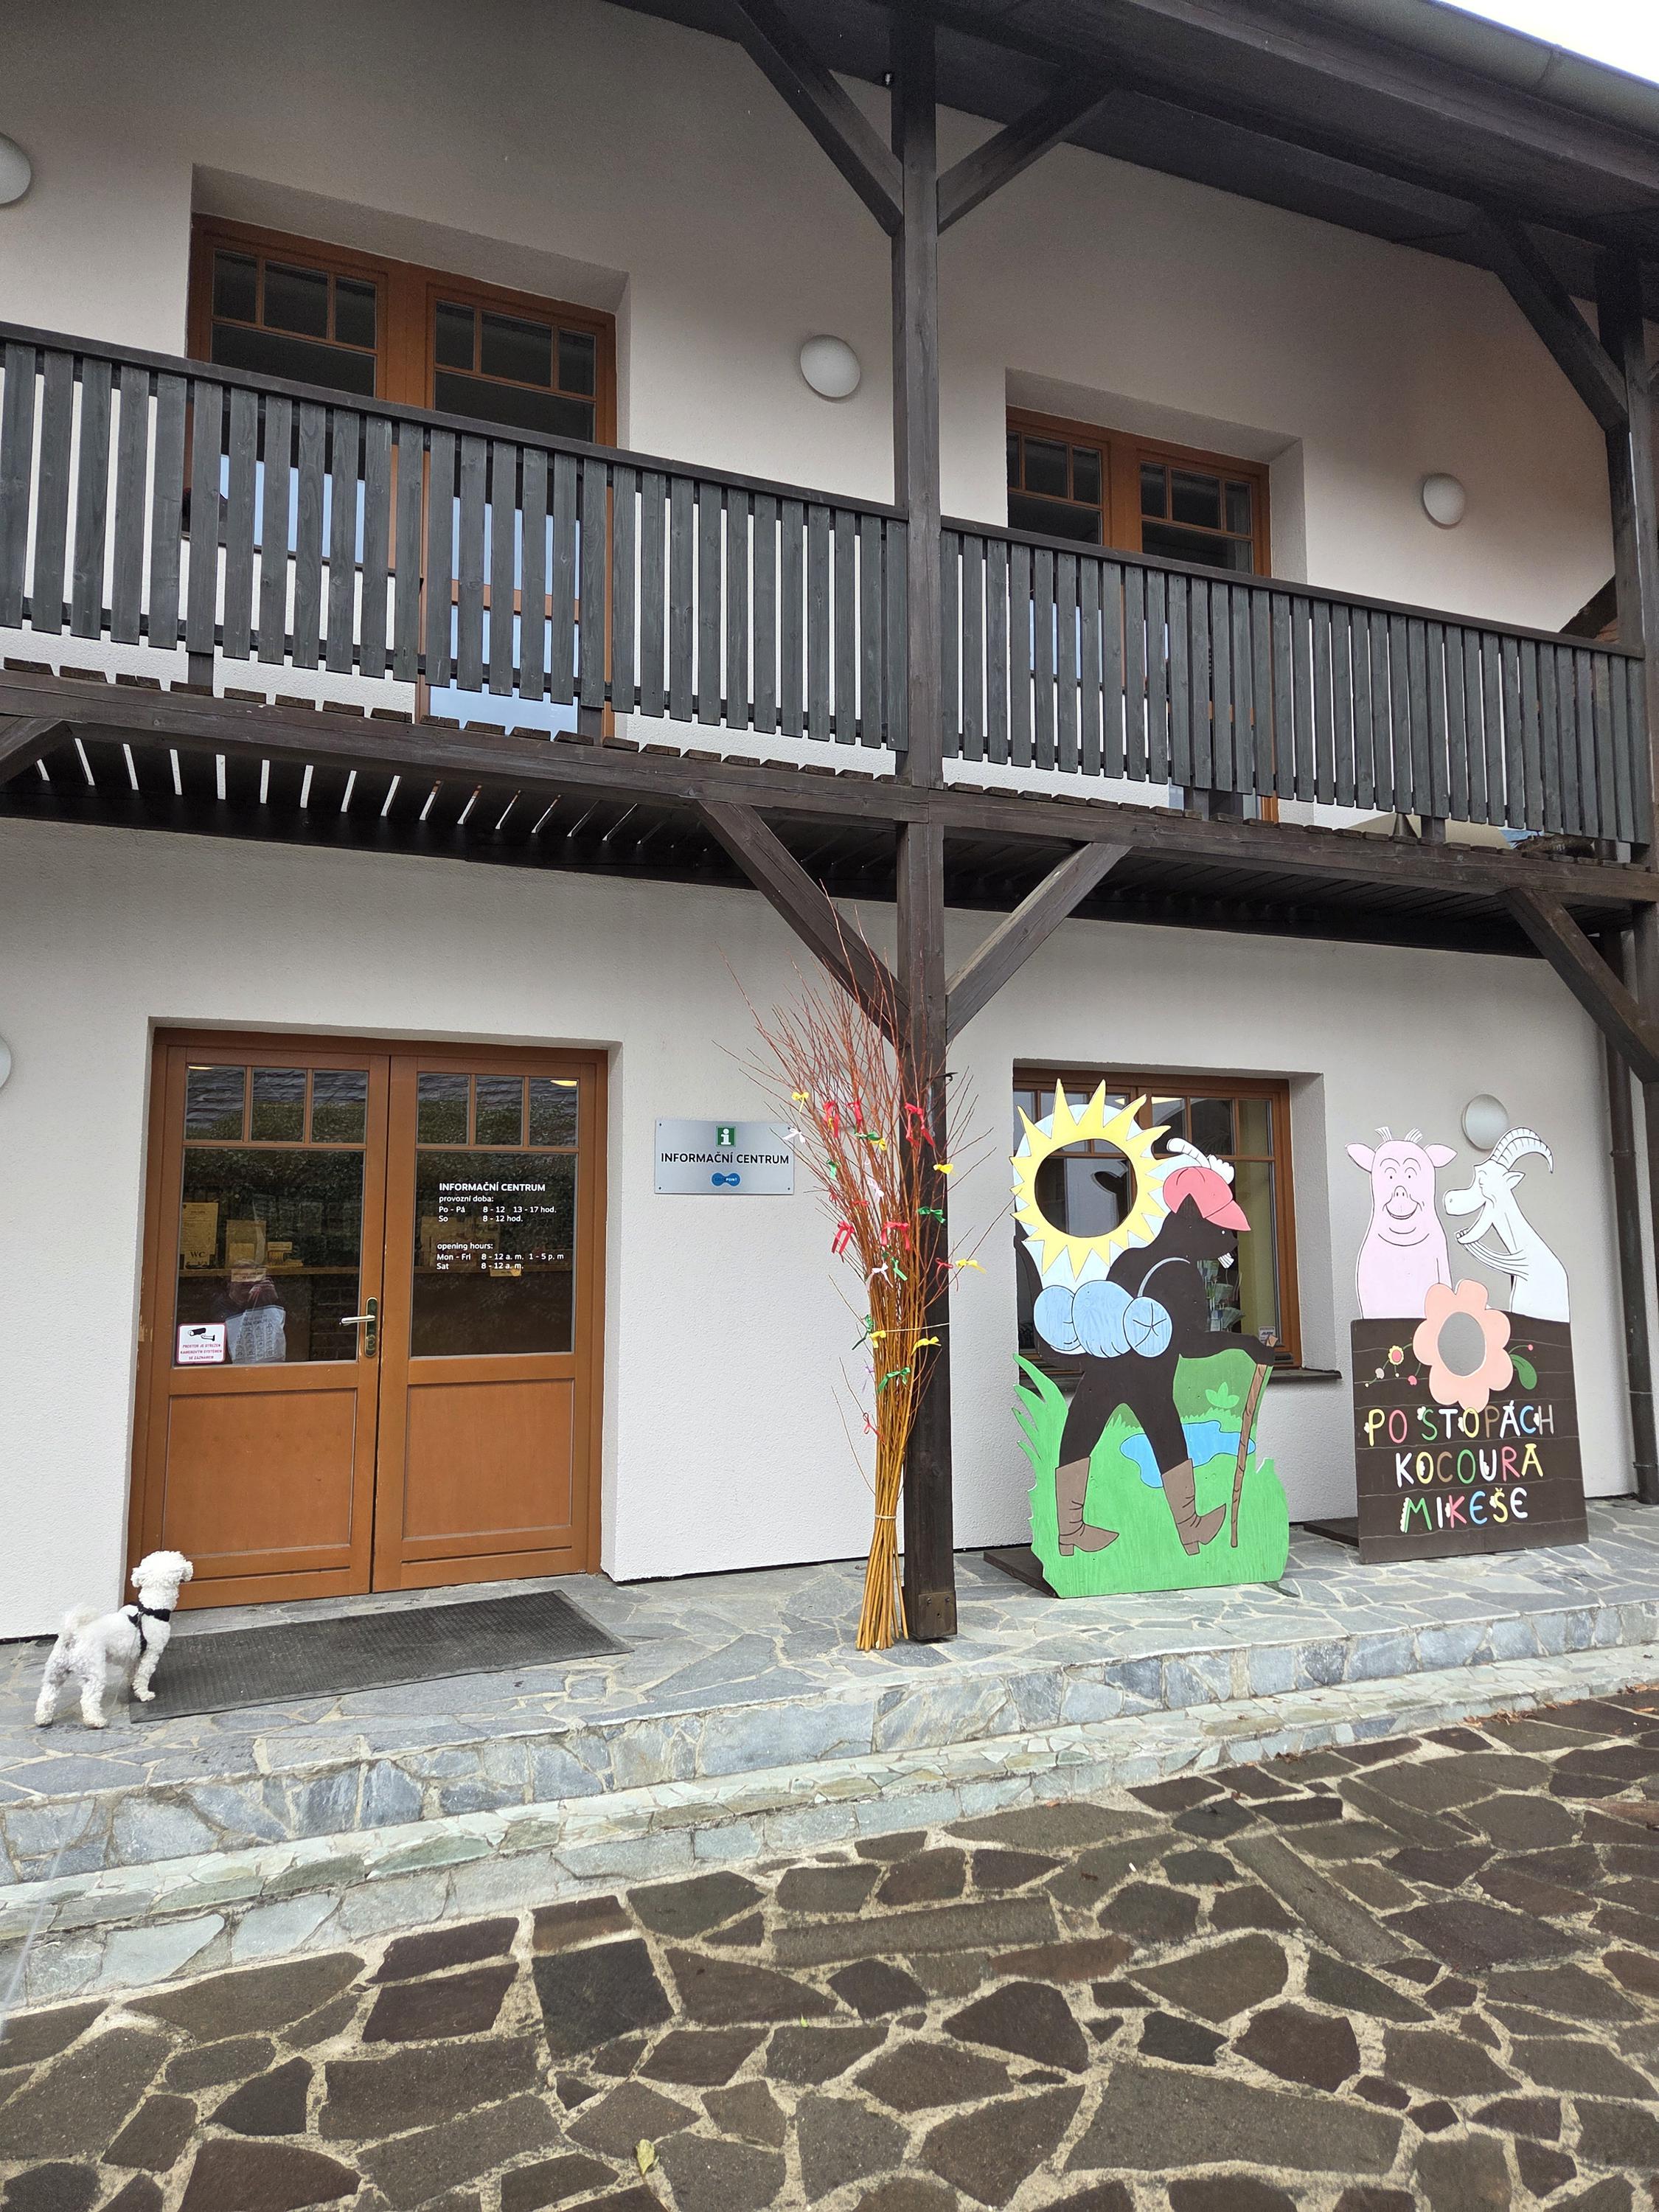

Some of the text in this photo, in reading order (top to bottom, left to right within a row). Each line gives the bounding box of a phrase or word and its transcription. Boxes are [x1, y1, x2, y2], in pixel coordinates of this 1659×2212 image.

[661, 1152, 788, 1164] INFORMAČNÍ CENTRUM
[439, 1182, 498, 1191] INFORMAČNÍ
[439, 1195, 471, 1203] provozní
[437, 1242, 467, 1251] opening
[1368, 1400, 1554, 1447] PO STOPÁCH
[1395, 1444, 1544, 1488] KOCOURA
[1404, 1486, 1528, 1533] MIKEŠE
